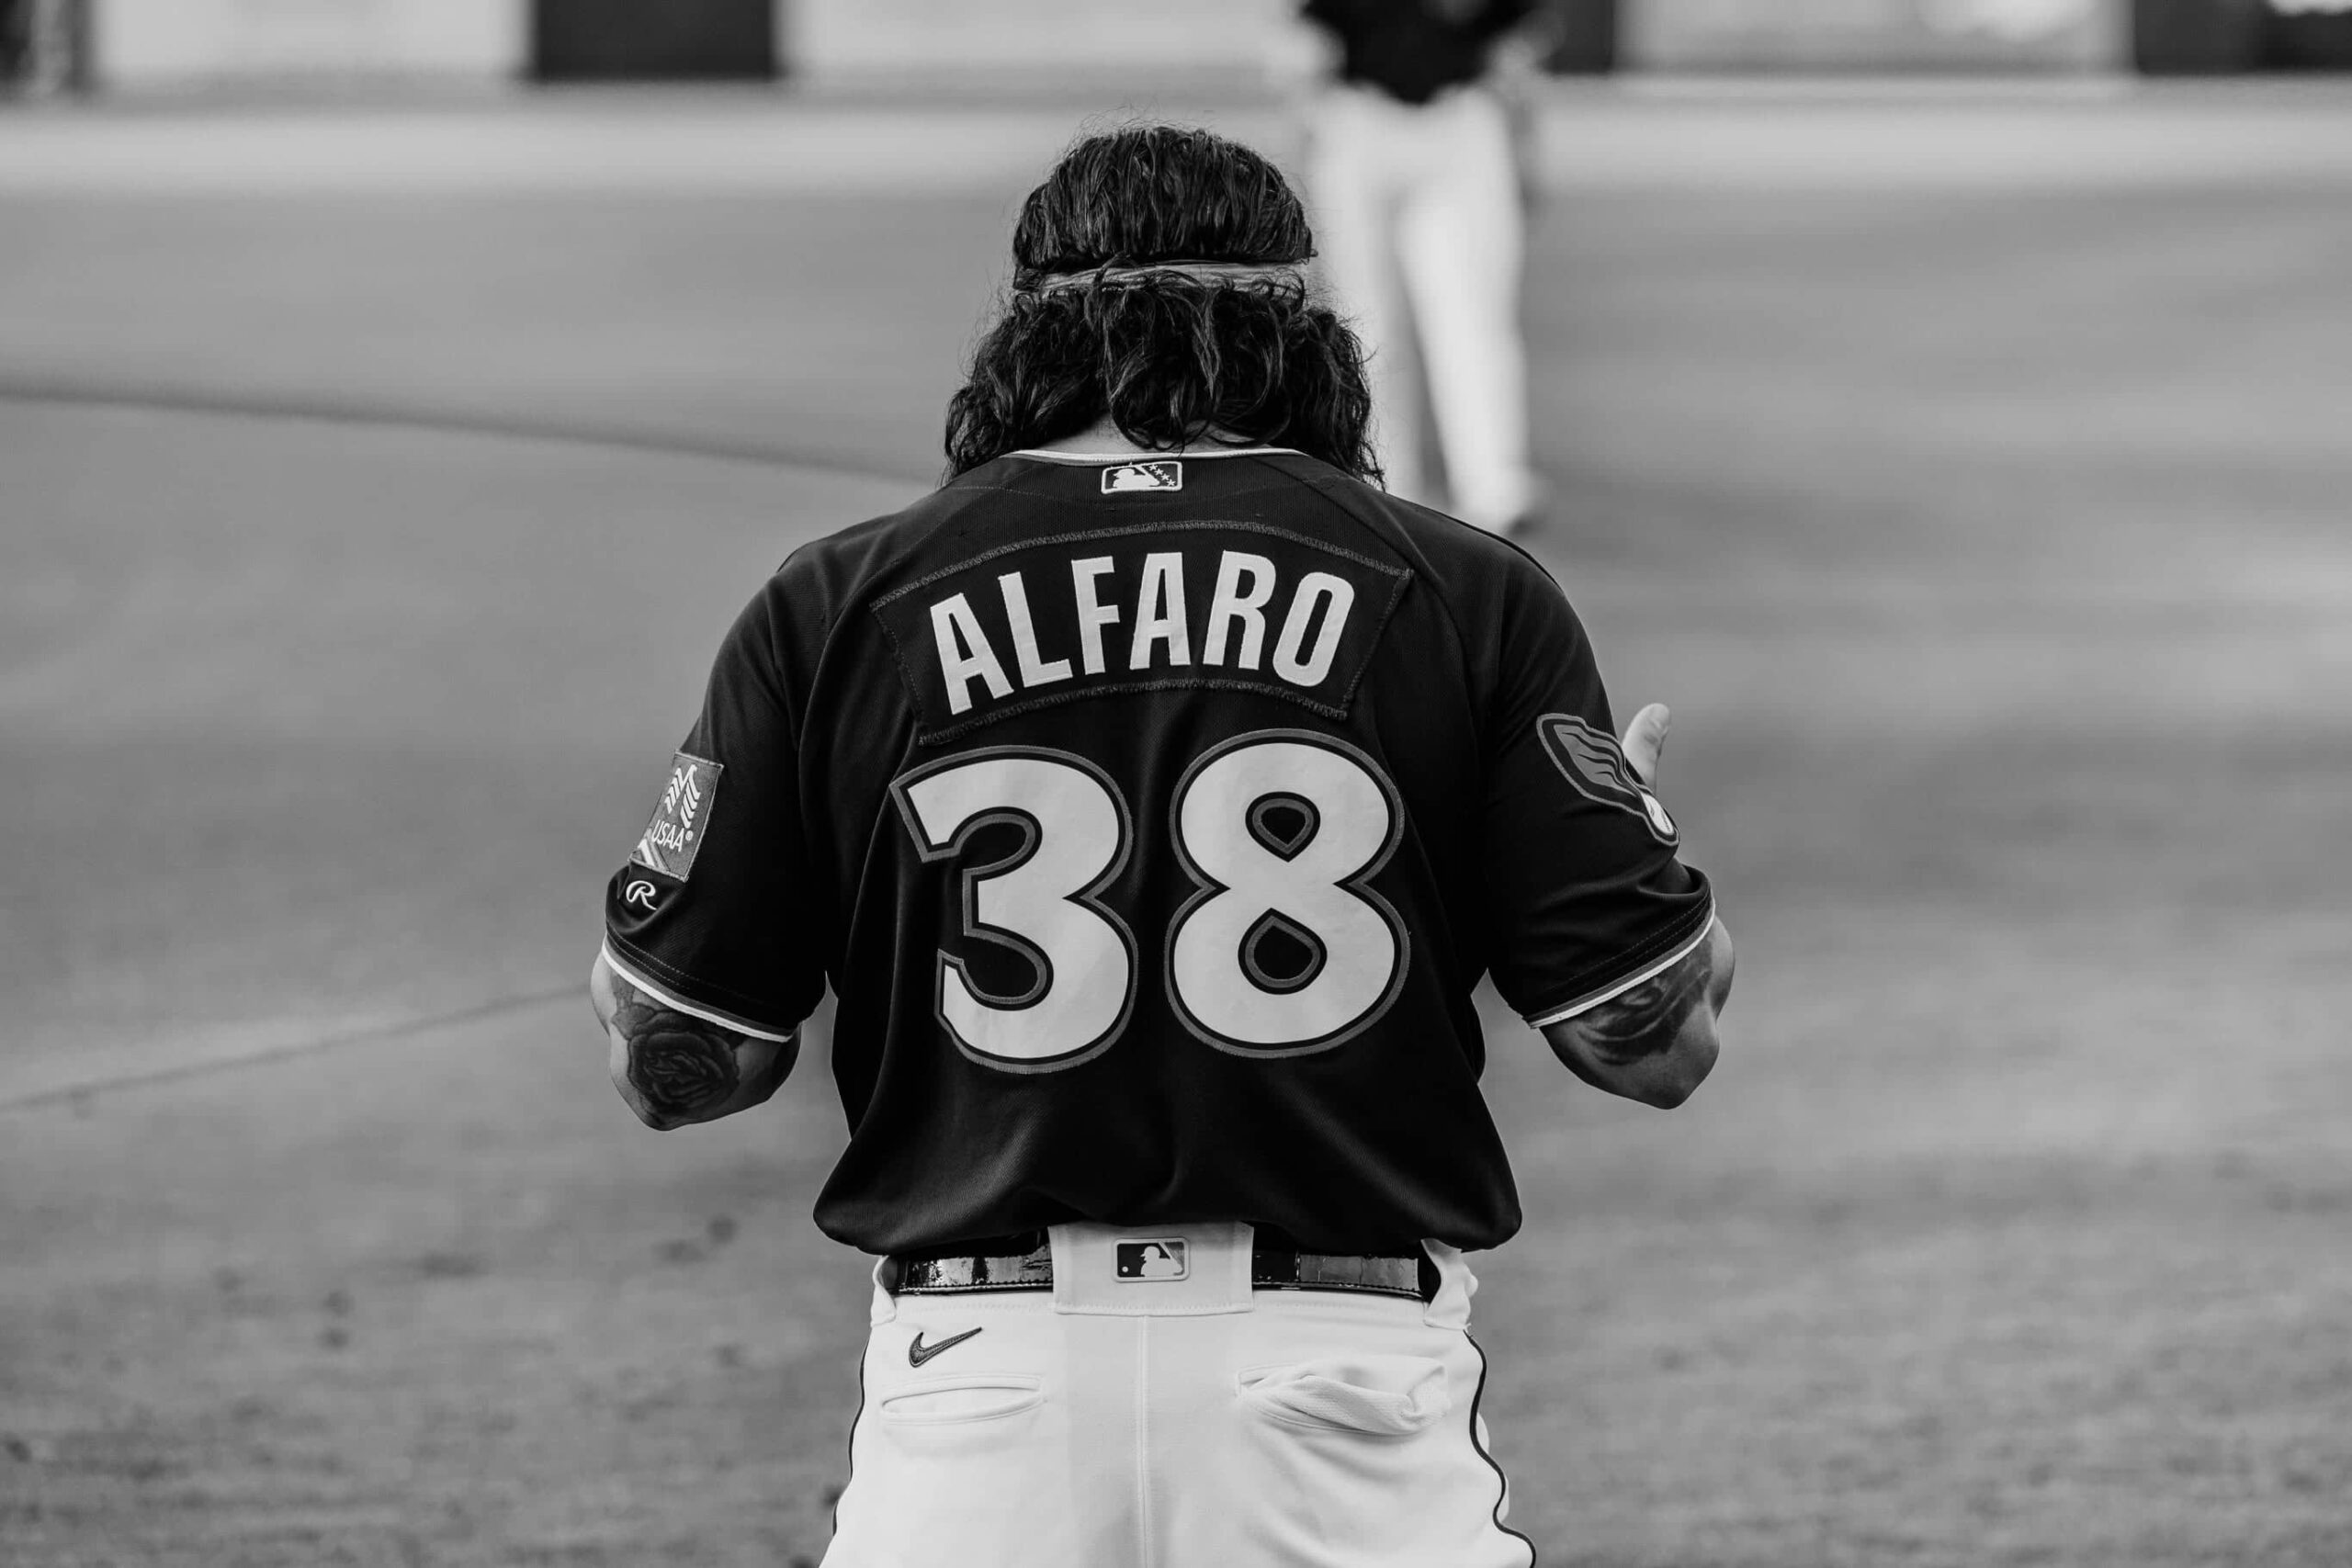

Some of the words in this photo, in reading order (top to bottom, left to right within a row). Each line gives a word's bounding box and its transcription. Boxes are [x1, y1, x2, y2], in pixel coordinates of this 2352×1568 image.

[930, 550, 1355, 716] ALFARO
[651, 819, 685, 852] USAA
[626, 880, 659, 910] R
[888, 728, 1410, 1074] 38
